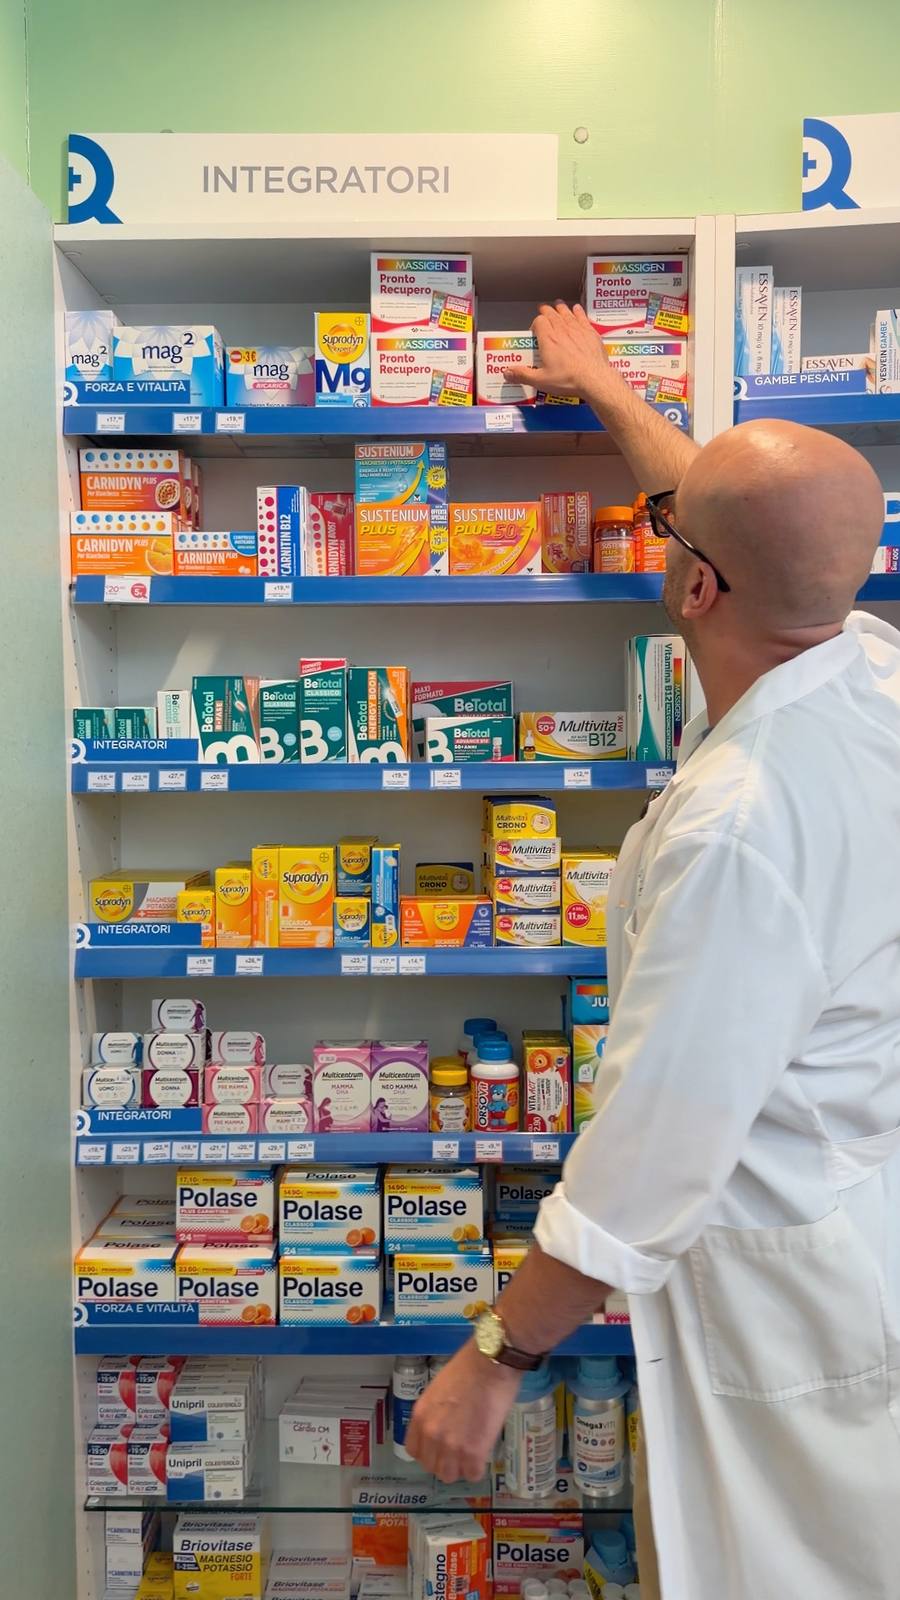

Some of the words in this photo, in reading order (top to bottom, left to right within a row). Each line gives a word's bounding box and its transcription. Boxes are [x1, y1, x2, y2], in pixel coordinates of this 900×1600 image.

[203, 165, 450, 194] INTEGRATORI
[395, 261, 449, 271] MASSIGEN
[611, 262, 665, 273] MASSIGEN
[379, 274, 416, 284] Pronto
[595, 277, 632, 287] Pronto
[379, 284, 431, 296] Recupero
[595, 287, 647, 299] Recupero
[755, 273, 768, 321] ESSAVEN
[595, 299, 633, 309] ENERGIA
[786, 289, 798, 331] ESSAVEN
[322, 333, 364, 346] Supradyn
[395, 339, 449, 349] MASSIGEN
[610, 345, 664, 355] MASSIGEN
[379, 353, 415, 363] Pronto
[486, 353, 522, 363] Pronto
[607, 359, 631, 368] onto
[806, 357, 854, 371] ESSAVEN
[253, 363, 290, 380] mag
[315, 359, 371, 393] Mg
[379, 364, 431, 376] Recupero
[754, 373, 797, 387] GAMBE
[800, 371, 850, 384] PESANTI
[85, 381, 124, 392] FORZA
[127, 381, 134, 391] E
[136, 379, 187, 391] VITALITÀ
[358, 446, 414, 458] SUSTENIUM
[86, 476, 142, 490] CARNIDYN
[142, 477, 158, 485] PLUS
[453, 508, 528, 523] SUSTENIUM
[567, 495, 575, 524] PLUS
[280, 514, 292, 530] B12
[359, 509, 429, 523] SUSTENIUM
[577, 495, 587, 547] SUSTENIUM
[359, 524, 397, 536] PLUS
[454, 523, 492, 536] PLUS
[493, 523, 519, 540] 50
[567, 526, 575, 545] 50
[76, 539, 134, 552] CARNIDYN
[177, 552, 226, 564] CARNIDYN
[280, 531, 292, 576] CARNITIN
[328, 540, 339, 576] ARNIDYN
[664, 643, 673, 683] Vitamina
[304, 678, 342, 689] BeTotal
[368, 671, 378, 700] BOOM
[414, 685, 431, 694] MAXI
[262, 691, 296, 701] BeTotal
[304, 689, 342, 697] CLASSICO
[414, 689, 443, 702] FORMATO
[664, 685, 673, 702] B12
[454, 698, 506, 712] BeTotal
[201, 691, 215, 732] BeTotal
[357, 700, 368, 741] BeTotal
[368, 702, 378, 740] ENERGY
[559, 720, 618, 732] Multivita
[454, 727, 490, 738] BeTotal
[538, 723, 555, 732] 50+
[93, 740, 168, 750] INTEGRATORI
[588, 732, 617, 747] B12
[511, 845, 552, 854] Multivita
[342, 856, 368, 865] Supradyn
[283, 871, 329, 884] Supradyn
[566, 871, 609, 880] Multivita
[219, 886, 249, 895] Supradyn
[512, 883, 553, 893] Multivita
[95, 897, 131, 908] Supradyn
[182, 908, 211, 917] Supradyn
[98, 924, 171, 934] INTEGRATORI
[513, 921, 553, 930] Multivita
[528, 1080, 536, 1094] ACT
[528, 1094, 536, 1112] VITA
[98, 1110, 172, 1121] INTEGRATORI
[179, 1187, 258, 1207] Polase
[283, 1200, 363, 1221] Polase
[387, 1195, 467, 1216] Polase
[179, 1233, 192, 1241] 24
[283, 1247, 297, 1255] 24
[388, 1243, 401, 1251] 24
[78, 1276, 159, 1298] Polase
[179, 1276, 260, 1298] Polase
[283, 1276, 364, 1298] Polase
[398, 1271, 478, 1293] Polase
[95, 1304, 135, 1313] FORZA
[136, 1304, 144, 1312] E
[145, 1303, 195, 1313] VITALITÀ
[171, 1399, 205, 1411] Unipril
[293, 1424, 316, 1433] Cardio
[317, 1425, 330, 1433] CM
[168, 1458, 202, 1470] Unipril
[204, 1459, 240, 1467] COLESTEROLO
[359, 1491, 428, 1504] Briovitase
[180, 1539, 253, 1552] Briovitase
[199, 1554, 253, 1563] MAGNESIO
[277, 1555, 328, 1563] Briovitase
[496, 1543, 570, 1563] Polase
[203, 1563, 253, 1572] POTASSIO
[230, 1572, 253, 1581] FORTE
[273, 1580, 326, 1588] Briovitase
